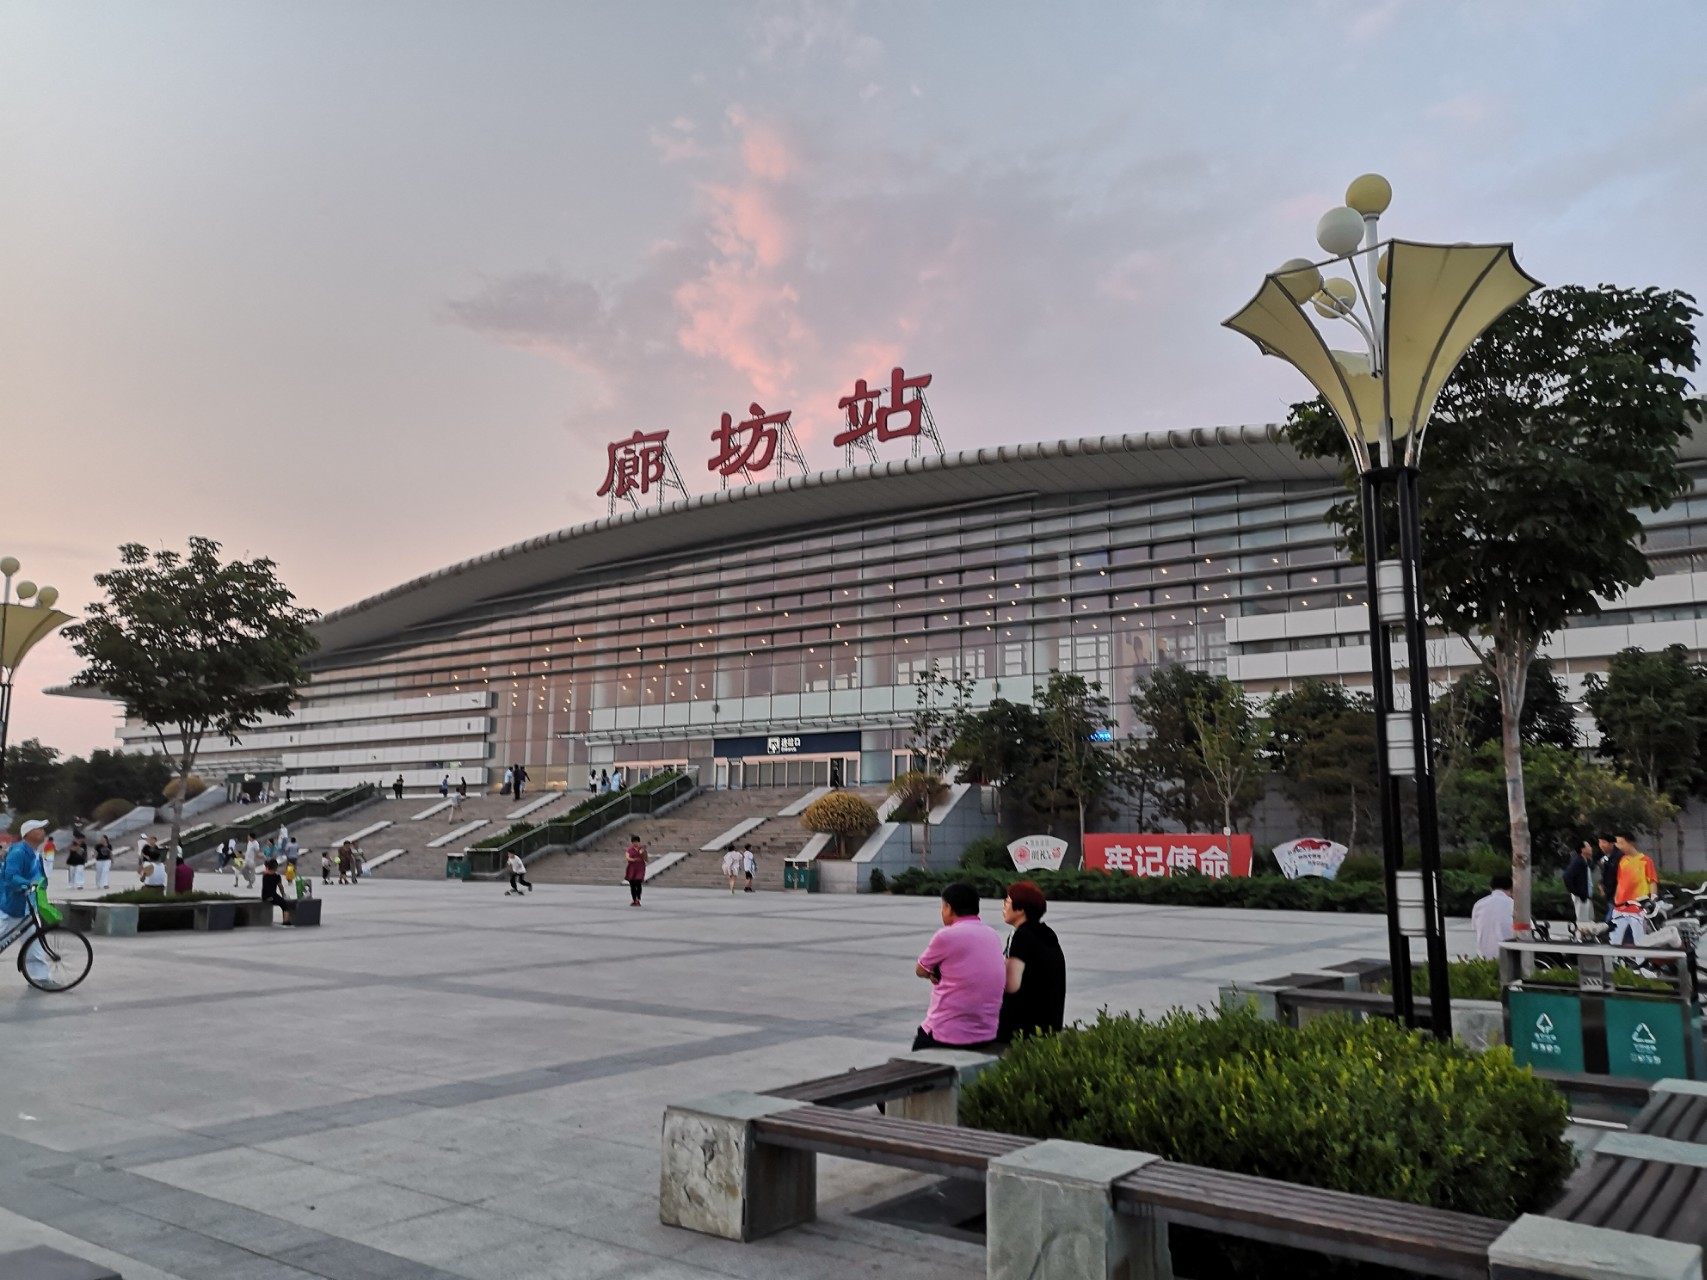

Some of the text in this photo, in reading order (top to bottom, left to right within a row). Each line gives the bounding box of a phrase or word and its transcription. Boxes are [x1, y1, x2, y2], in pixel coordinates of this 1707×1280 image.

[597, 367, 932, 497] 廊坊站
[1104, 845, 1230, 878] 牢记使命
